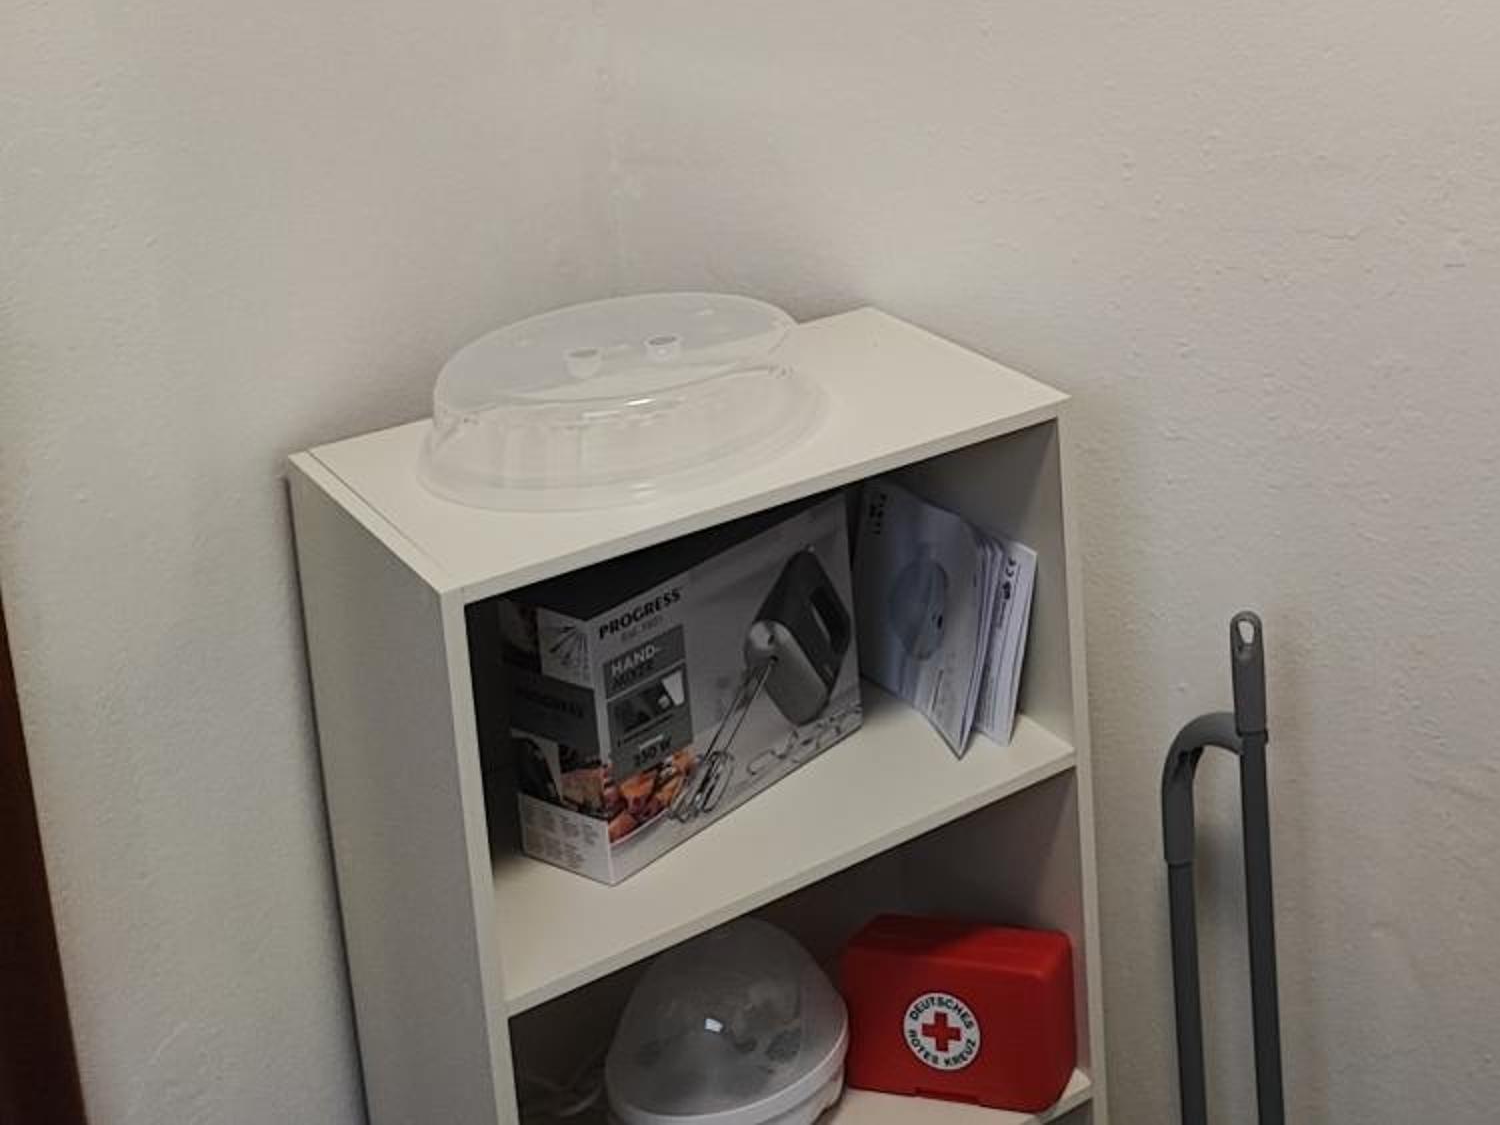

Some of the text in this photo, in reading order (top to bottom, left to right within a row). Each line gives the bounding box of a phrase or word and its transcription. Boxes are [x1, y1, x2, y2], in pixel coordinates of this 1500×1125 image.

[599, 587, 681, 640] PROGRESS
[909, 996, 974, 1029] DEUTSCHES
[908, 1029, 976, 1067] ROTES KREUZ
